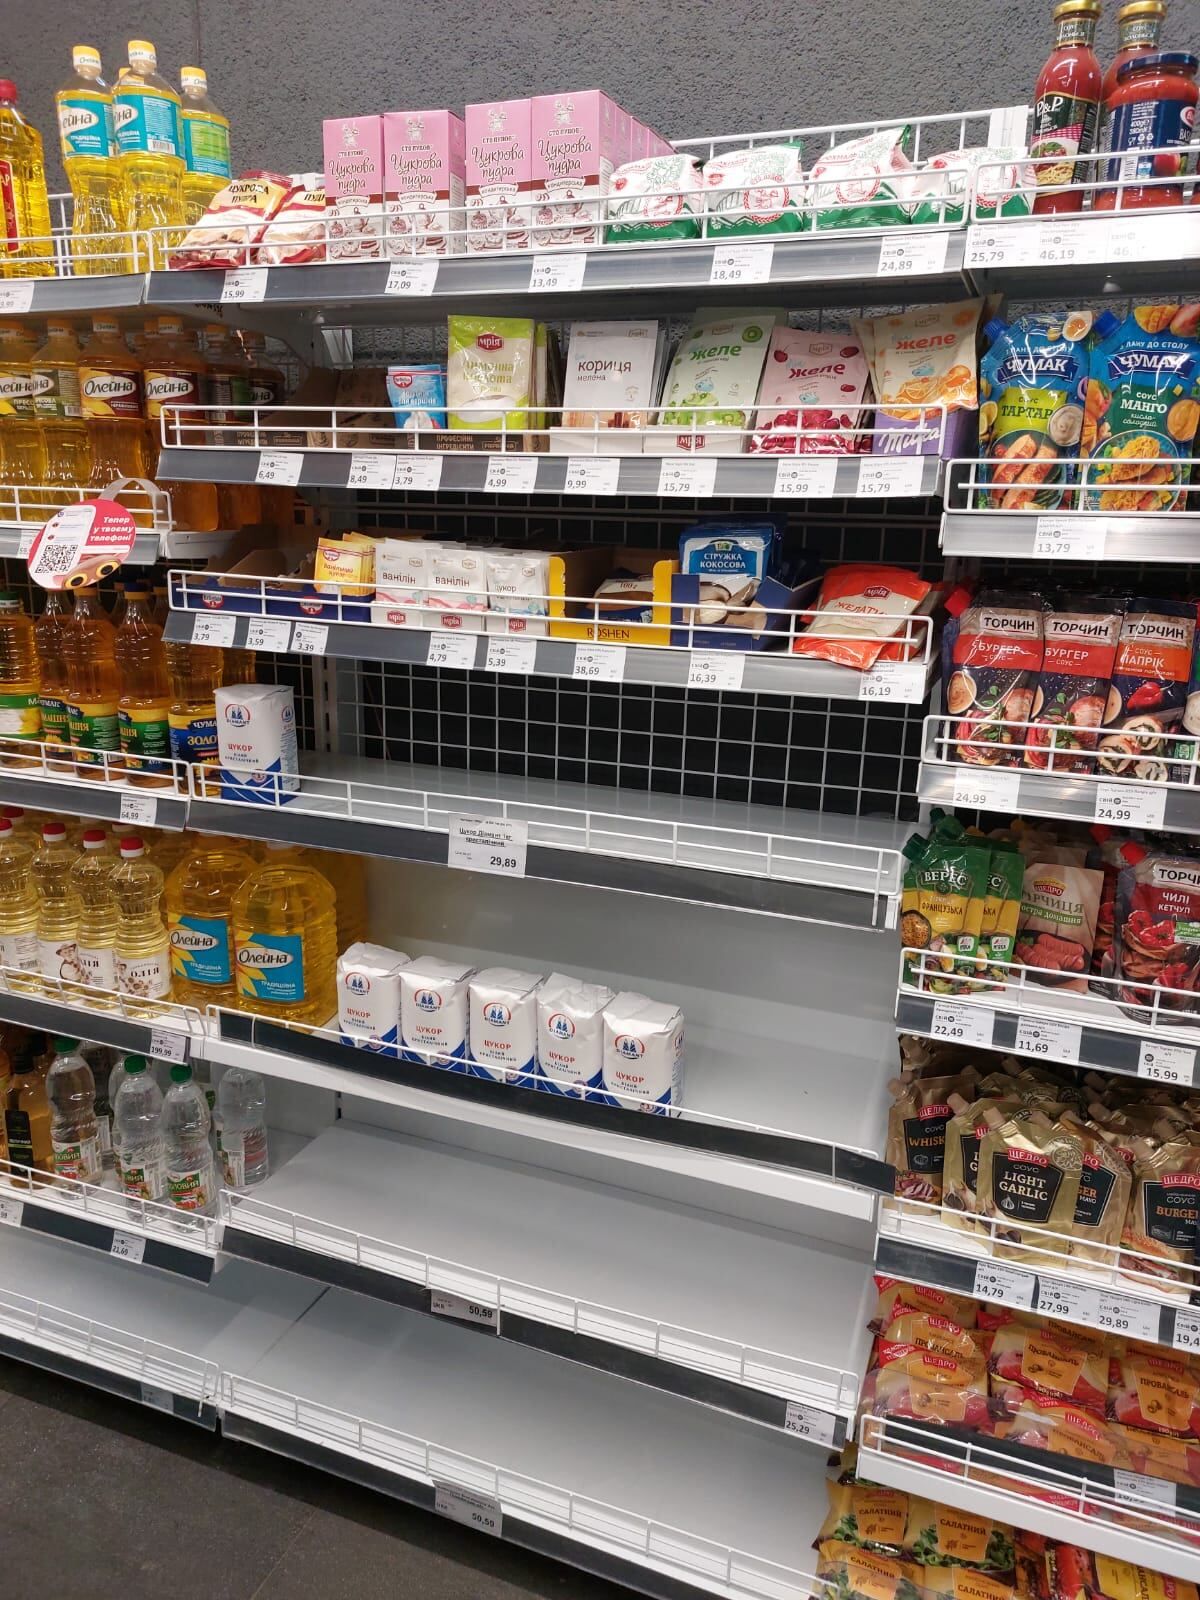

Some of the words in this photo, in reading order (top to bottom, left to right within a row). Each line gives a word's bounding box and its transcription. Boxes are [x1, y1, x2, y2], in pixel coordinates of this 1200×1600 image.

[537, 135, 592, 162] Цукрова
[471, 143, 524, 169] Цукрова
[328, 157, 375, 181] Цукрова
[390, 152, 442, 176] Цукрова
[548, 157, 582, 176] пудра
[482, 164, 514, 183] пудра
[338, 177, 366, 195] пудра
[401, 174, 433, 191] пудра
[970, 250, 1004, 262] 25,79
[1039, 249, 1075, 260] 46,19
[881, 260, 913, 272] 24,89
[712, 269, 742, 280] 18,49
[387, 280, 411, 289] 17,09
[532, 278, 559, 288] 13,49
[223, 290, 245, 299] 15,99
[895, 333, 957, 350] желе
[689, 343, 742, 361] желе
[578, 359, 632, 374] кориця
[788, 362, 846, 379] желе
[1006, 357, 1068, 373] ЧУМАК
[577, 374, 606, 382] мелена
[84, 380, 134, 396] Олейна
[1135, 391, 1158, 400] СОУС
[1001, 404, 1054, 419] ТАРТАР
[1120, 398, 1168, 414] МАНГО
[258, 470, 276, 481] 6,49
[349, 475, 367, 485] 8,49
[395, 476, 413, 486] 3,79
[487, 478, 507, 488] 4,99
[567, 479, 587, 490] 9,99
[663, 482, 690, 492] 15,79
[779, 483, 809, 494] 15,99
[860, 482, 891, 494] 15,79
[103, 516, 130, 524] Тепер
[1036, 543, 1071, 554] 13,79
[703, 552, 743, 561] СТРУЖКА
[699, 560, 747, 570] КОКОСОВА
[382, 572, 416, 585] ванілін
[435, 575, 470, 588] ванілін
[984, 616, 1035, 631] ТОРЧИН
[1052, 621, 1109, 636] ТОРЧИН
[193, 632, 210, 642] 3,79
[587, 627, 630, 639] ROSHEN
[1127, 624, 1185, 640] ТОРЧИН
[247, 637, 264, 647] 3,59
[428, 653, 448, 663] 4,79
[1044, 647, 1089, 660] БУРГЕР
[488, 657, 506, 668] 5,39
[574, 665, 600, 676] 38,69
[689, 672, 717, 684] 16,39
[861, 686, 891, 697] 16,19
[187, 735, 218, 746] ЗОЛО
[227, 743, 253, 753] ЦУКОР
[955, 792, 987, 805] 24,99
[1098, 808, 1131, 821] 24,99
[490, 856, 517, 869] 29,89
[924, 868, 969, 888] ВЕРЕС
[1162, 892, 1190, 904] ЧИЛІ
[1157, 903, 1191, 915] КЕТЧУП
[1043, 910, 1082, 925] домашня
[170, 931, 214, 947] Олейна
[238, 949, 288, 964] Олейна
[346, 1007, 372, 1019] ЦУКОР
[415, 1025, 443, 1036] ЦУКОР
[934, 1025, 964, 1038] 22,49
[483, 1039, 512, 1050] ЦУКОР
[1018, 1040, 1049, 1053] 11,69
[548, 1050, 576, 1064] ЦУКОР
[615, 1071, 645, 1084] ЦУКОР
[919, 1104, 950, 1119] ЩЕДРО
[1008, 1149, 1048, 1166] ЩЕДРО
[1012, 1163, 1040, 1174] СОУС
[1003, 1171, 1047, 1188] LIGHT
[998, 1181, 1049, 1202] GARLIC
[1166, 1195, 1196, 1205] СОУС
[975, 1284, 1005, 1298] 14,79
[468, 1305, 494, 1319] 50,59
[1039, 1300, 1070, 1315] 27,99
[1098, 1315, 1130, 1330] 29,89
[1175, 1333, 1200, 1347] 19,4
[923, 1355, 957, 1372] ЩЕДРО
[785, 1420, 811, 1435] 25,29
[858, 1507, 903, 1519] САЛАТНИЙ
[939, 1518, 988, 1537] САЛАТНИЙ
[849, 1555, 896, 1580] САЛАТНИЙ
